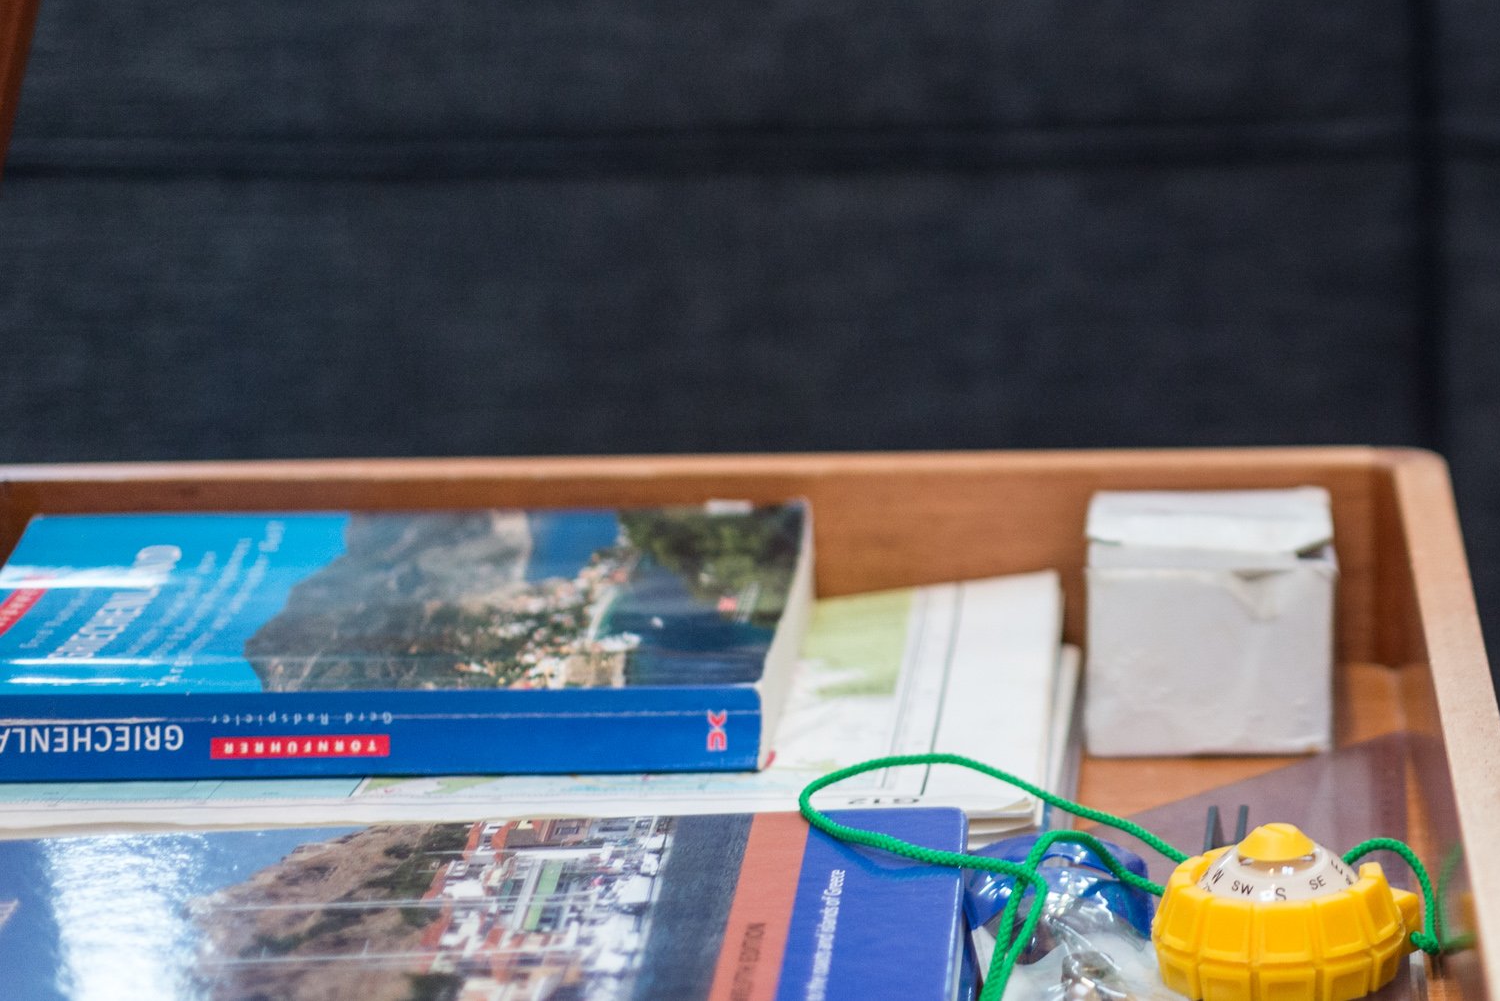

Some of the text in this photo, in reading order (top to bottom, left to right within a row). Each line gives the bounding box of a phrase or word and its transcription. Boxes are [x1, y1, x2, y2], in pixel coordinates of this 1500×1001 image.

[211, 712, 392, 726] Gerd Radspieler
[823, 869, 845, 896] Greece
[1231, 880, 1254, 896] SW
[1275, 887, 1287, 901] S
[1309, 875, 1327, 891] SE
[820, 896, 840, 906] of
